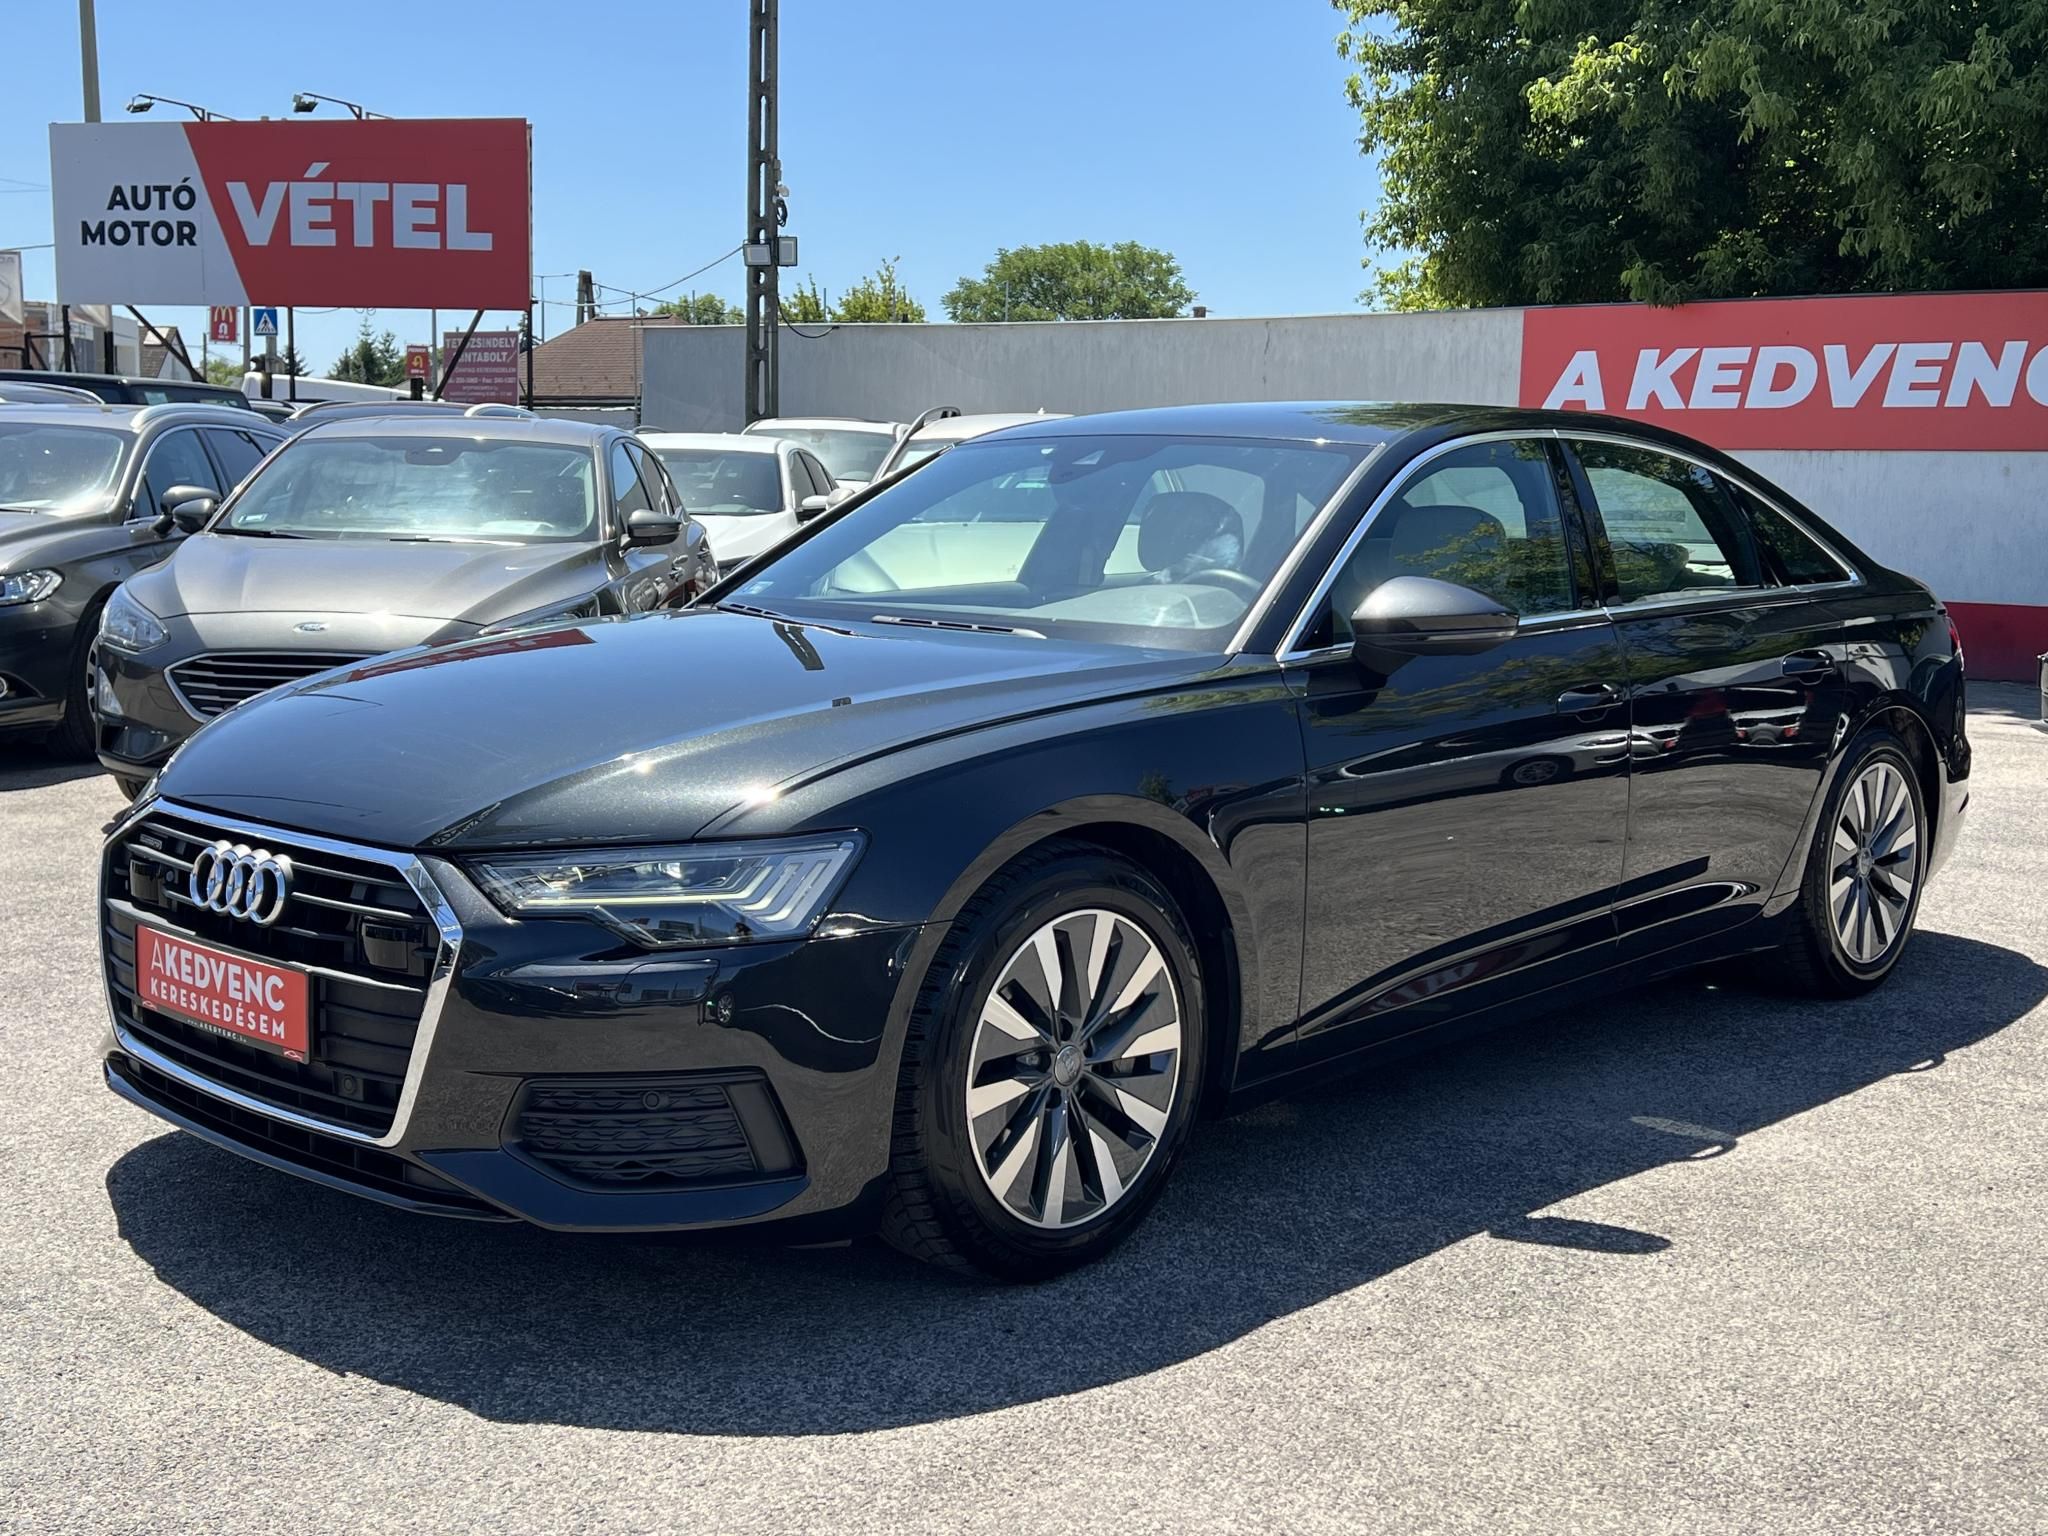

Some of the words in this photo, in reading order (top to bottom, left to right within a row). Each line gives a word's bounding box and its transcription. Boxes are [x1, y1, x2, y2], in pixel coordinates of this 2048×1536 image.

[107, 177, 196, 211] AUTÓ
[226, 162, 493, 251] VÉTEL
[81, 220, 197, 247] MOTOR
[1543, 350, 1606, 410] A
[151, 977, 286, 1041] KERESKEDÉSEM
